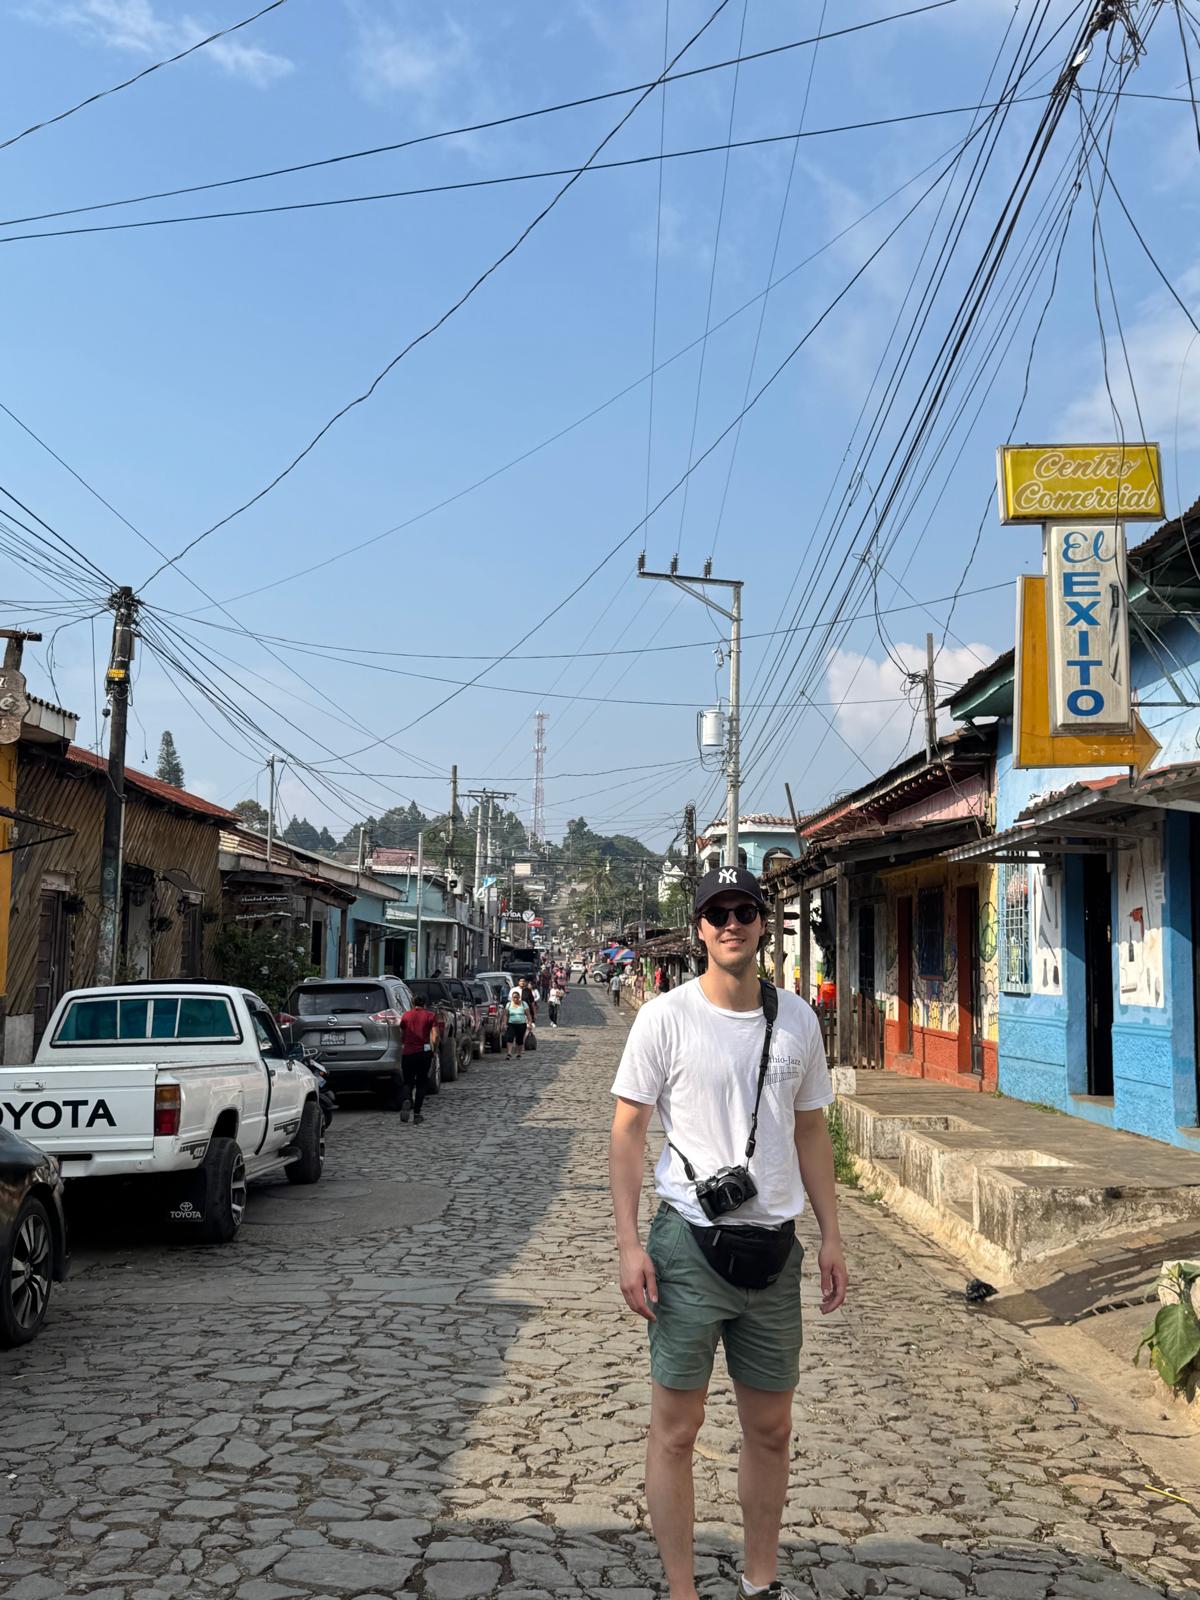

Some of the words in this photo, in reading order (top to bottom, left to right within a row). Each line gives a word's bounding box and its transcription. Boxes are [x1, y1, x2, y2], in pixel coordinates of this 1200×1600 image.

[1034, 451, 1140, 480] Centro
[1014, 480, 1156, 512] Comercial
[1062, 530, 1116, 564] El
[1062, 571, 1105, 717] EXITO
[170, 1210, 202, 1219] TOYOTA
